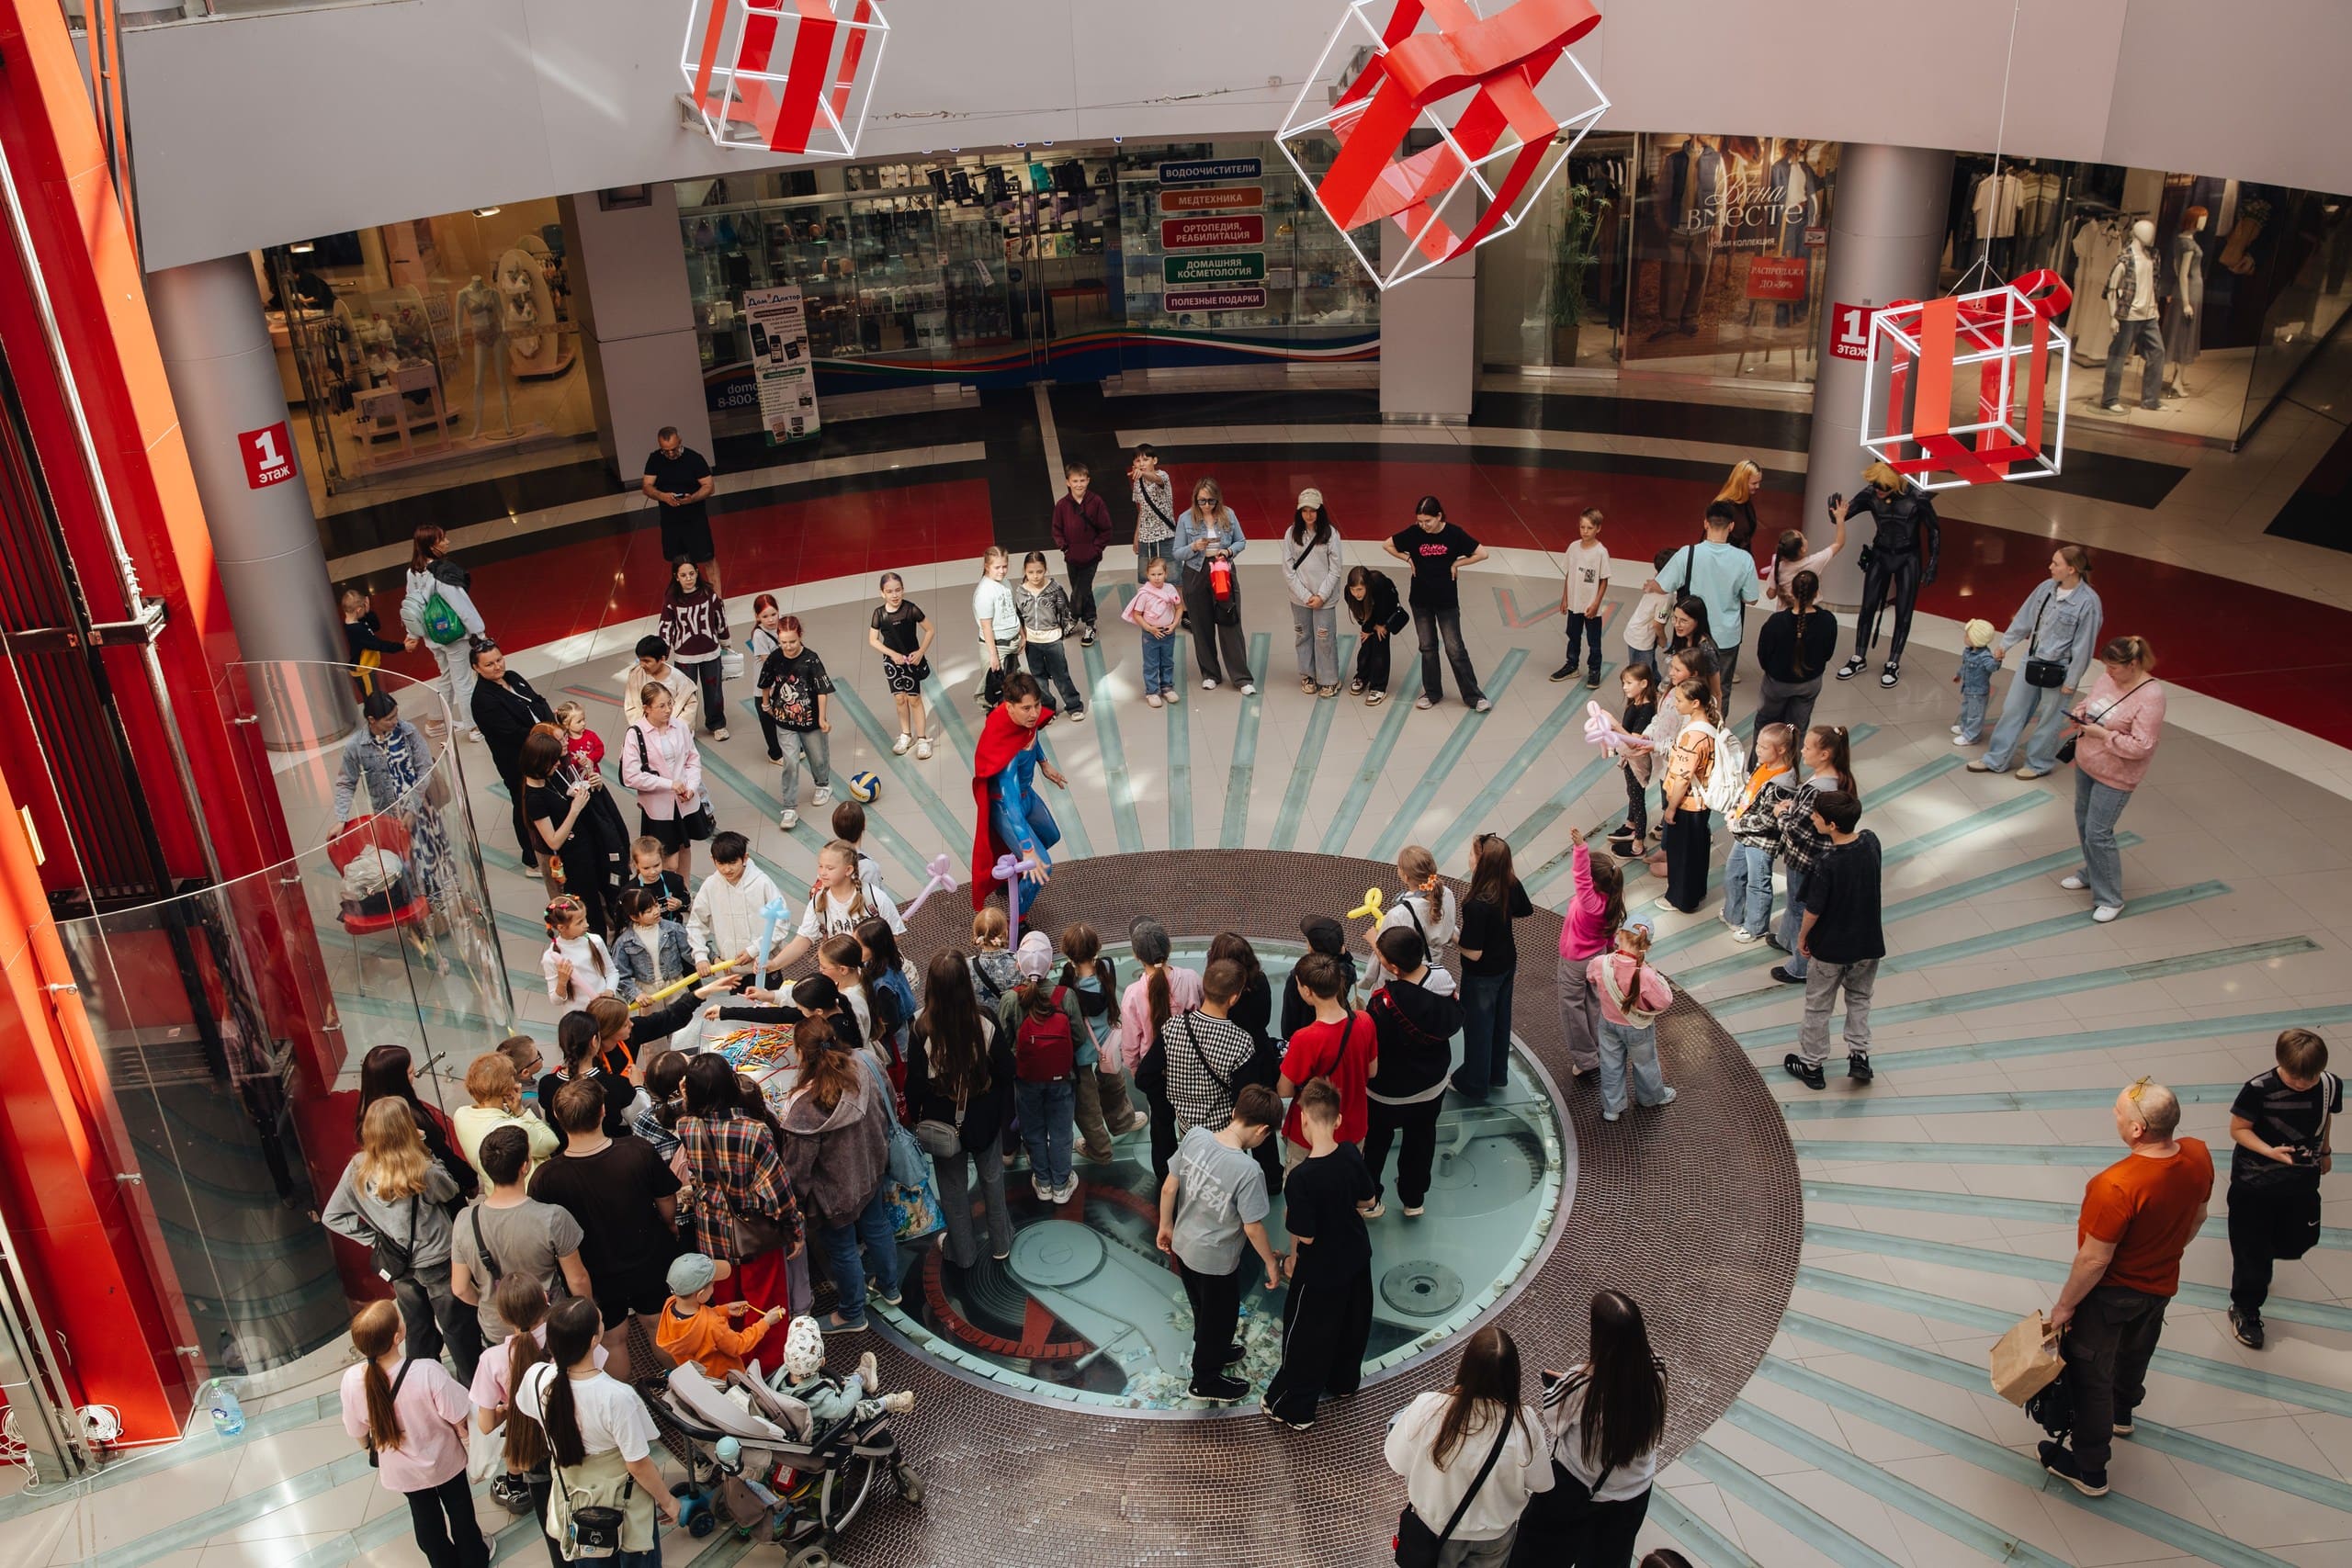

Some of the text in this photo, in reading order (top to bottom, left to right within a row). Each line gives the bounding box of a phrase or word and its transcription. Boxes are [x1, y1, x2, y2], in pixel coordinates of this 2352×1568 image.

[1165, 164, 1256, 178] ВОДООЧИСТИТЕЛИ
[1178, 193, 1243, 207] МЕДТЕХНИКА
[1182, 222, 1242, 233] ОРТОПЕДИЯ,
[1176, 231, 1250, 243] РЕАБИЛИТАЦИЯ
[1186, 258, 1242, 270] ДОМАШНЯЯ
[1750, 265, 1804, 276] РАСПРОДАЖА
[1178, 266, 1252, 279] КОСМЕТОЛОГИЯ
[1758, 279, 1773, 288] ДО
[1171, 294, 1260, 307] ПОЛЕЗНЫЕ ПОДАРКИ
[1840, 309, 1867, 345] 1
[1837, 344, 1868, 357] этаж
[254, 430, 285, 471] 1
[258, 465, 290, 483] этаж
